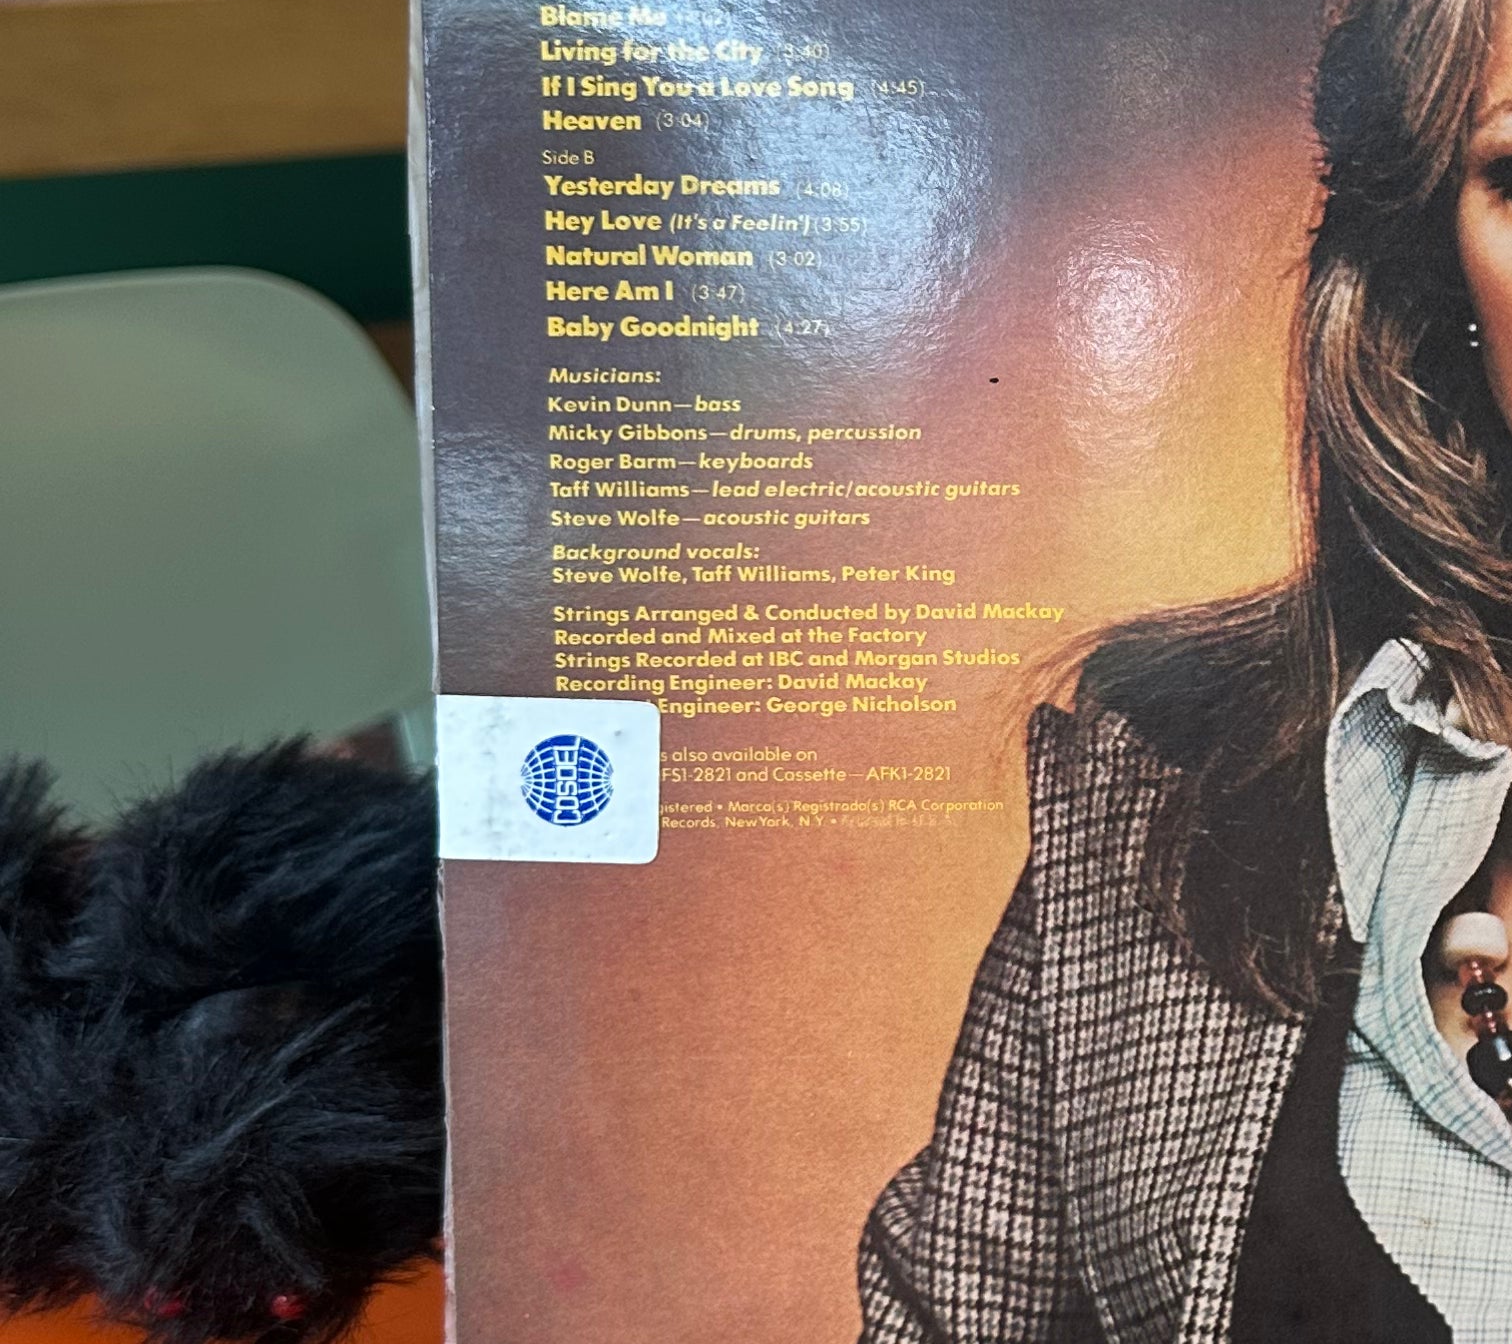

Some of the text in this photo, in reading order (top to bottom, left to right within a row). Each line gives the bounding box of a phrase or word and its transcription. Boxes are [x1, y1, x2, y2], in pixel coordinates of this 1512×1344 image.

[540, 4, 624, 27] Blame
[540, 39, 617, 67] Living
[623, 38, 660, 63] for
[667, 37, 710, 62] the
[714, 38, 764, 66] City
[542, 76, 565, 98] If
[567, 77, 576, 97] I
[581, 75, 638, 102] Sing
[641, 76, 698, 98] You
[699, 80, 715, 97] a
[720, 76, 781, 99] Love
[787, 75, 855, 102] Song
[542, 110, 642, 132] Heaven
[542, 149, 595, 166] Side B
[543, 173, 675, 200] Yesterday
[681, 174, 780, 197] Dreams
[544, 210, 595, 236] Hey
[601, 211, 662, 232] Love
[669, 214, 708, 234] (It's
[712, 219, 727, 232] a
[546, 244, 647, 267] Natural
[651, 245, 754, 267] Woman
[546, 281, 609, 302] Here
[615, 281, 661, 302] Am
[663, 281, 675, 302] I
[547, 315, 831, 342] Baby Goodnight (427)
[548, 367, 661, 384] Musicians:
[548, 396, 611, 413] Kevin
[548, 425, 612, 444] Micky
[807, 426, 922, 444] percussion
[549, 453, 614, 474] Roger
[550, 480, 592, 498] Taff
[765, 478, 940, 499] electric/acoustic
[943, 479, 1021, 501] guitars
[551, 509, 612, 527] Steve
[793, 508, 871, 529] guitars
[553, 542, 760, 564] Background vocals:
[552, 565, 956, 586] Steve Wolfe, Taff Williams, Peter King
[553, 602, 1065, 626] Strings Arranged & Conducted by David Mackay
[554, 627, 927, 648] Recorded and Mixed at the Factory
[554, 649, 1020, 670] Strings Recorded at IBC and Morgan Studios
[556, 673, 928, 695] Recording Engineer: David Mackay
[658, 698, 761, 716] Engineer:
[766, 697, 847, 716] George
[852, 696, 957, 713] Nicholson
[672, 746, 708, 762] also
[711, 745, 792, 762] available
[796, 750, 817, 762] on
[736, 765, 769, 782] and
[728, 800, 790, 814] Marca(s)
[888, 799, 918, 810] RCA
[921, 798, 1004, 814] Corporation
[725, 815, 757, 828] New
